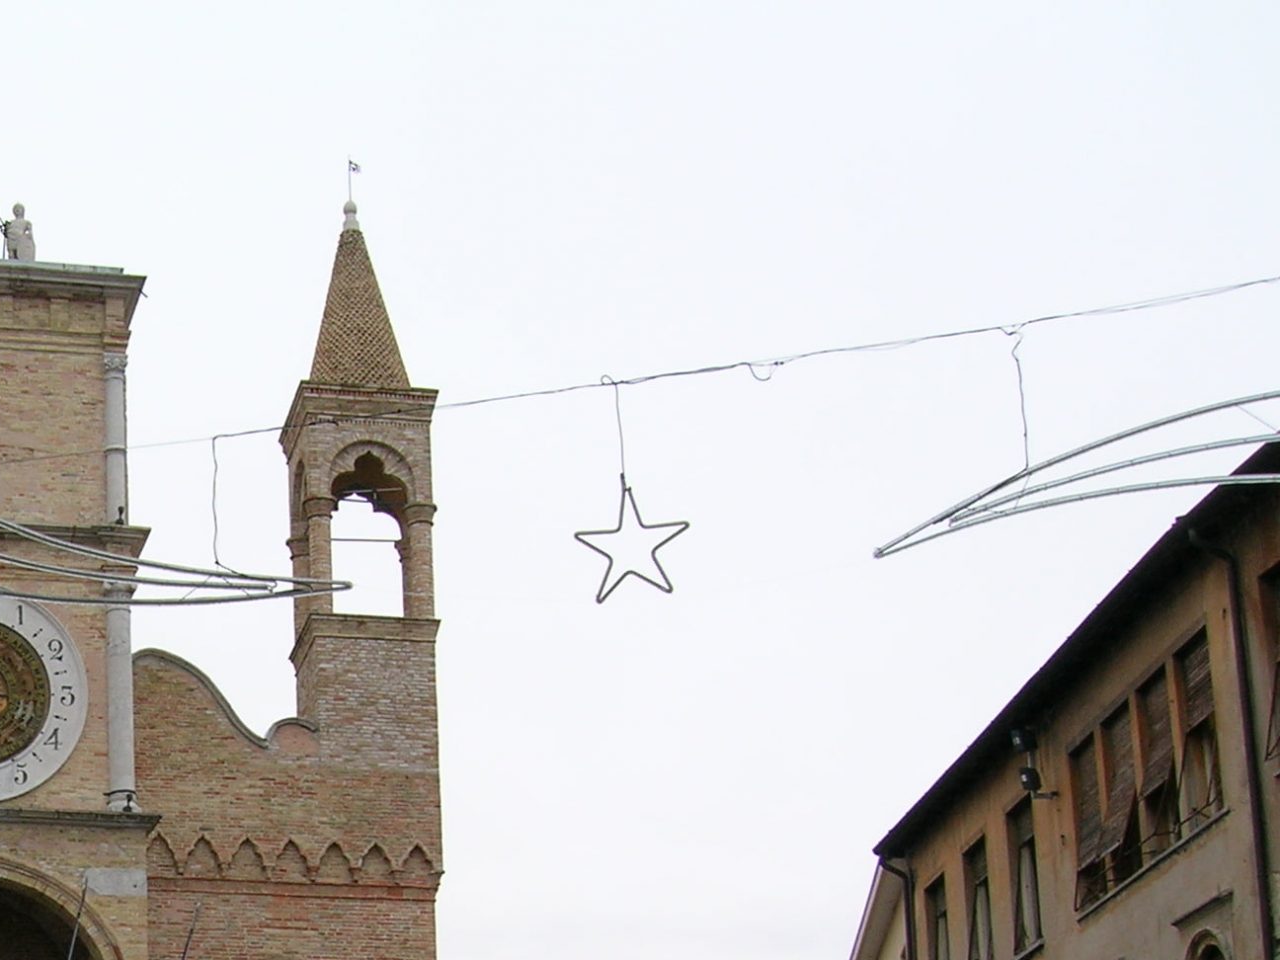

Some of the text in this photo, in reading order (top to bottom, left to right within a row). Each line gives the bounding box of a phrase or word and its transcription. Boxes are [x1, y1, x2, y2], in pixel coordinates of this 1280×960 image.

[17, 604, 24, 626] 1
[48, 638, 64, 662] 2
[60, 685, 76, 706] 3
[43, 727, 63, 751] 4
[14, 764, 28, 785] 5
